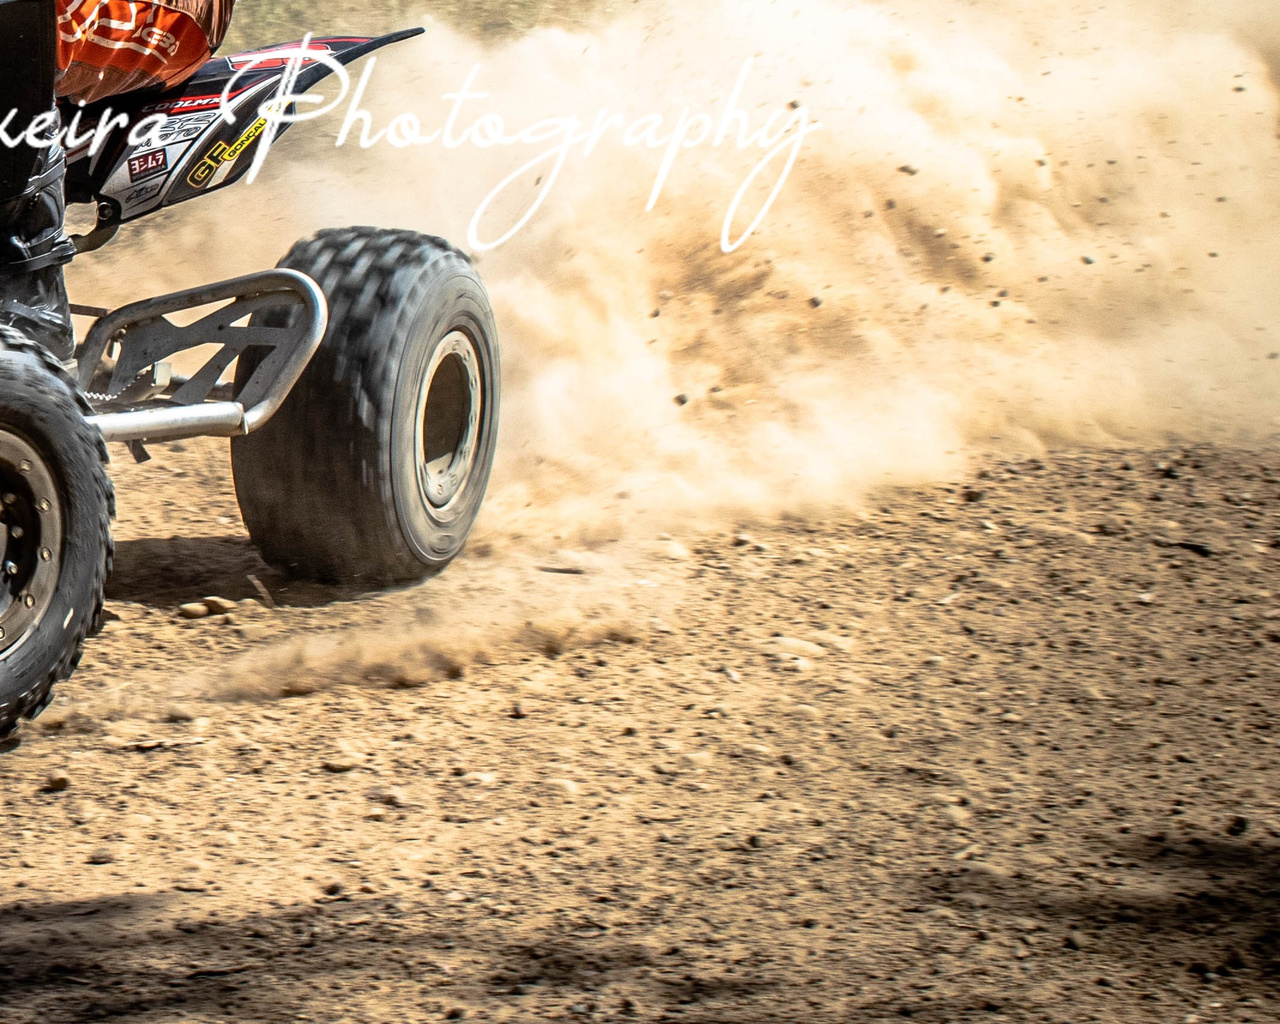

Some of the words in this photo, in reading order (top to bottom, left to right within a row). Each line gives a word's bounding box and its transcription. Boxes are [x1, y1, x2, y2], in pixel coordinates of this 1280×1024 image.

[141, 97, 222, 112] COOLMX
[130, 151, 165, 175] ヨシムラ
[187, 141, 230, 188] GF
